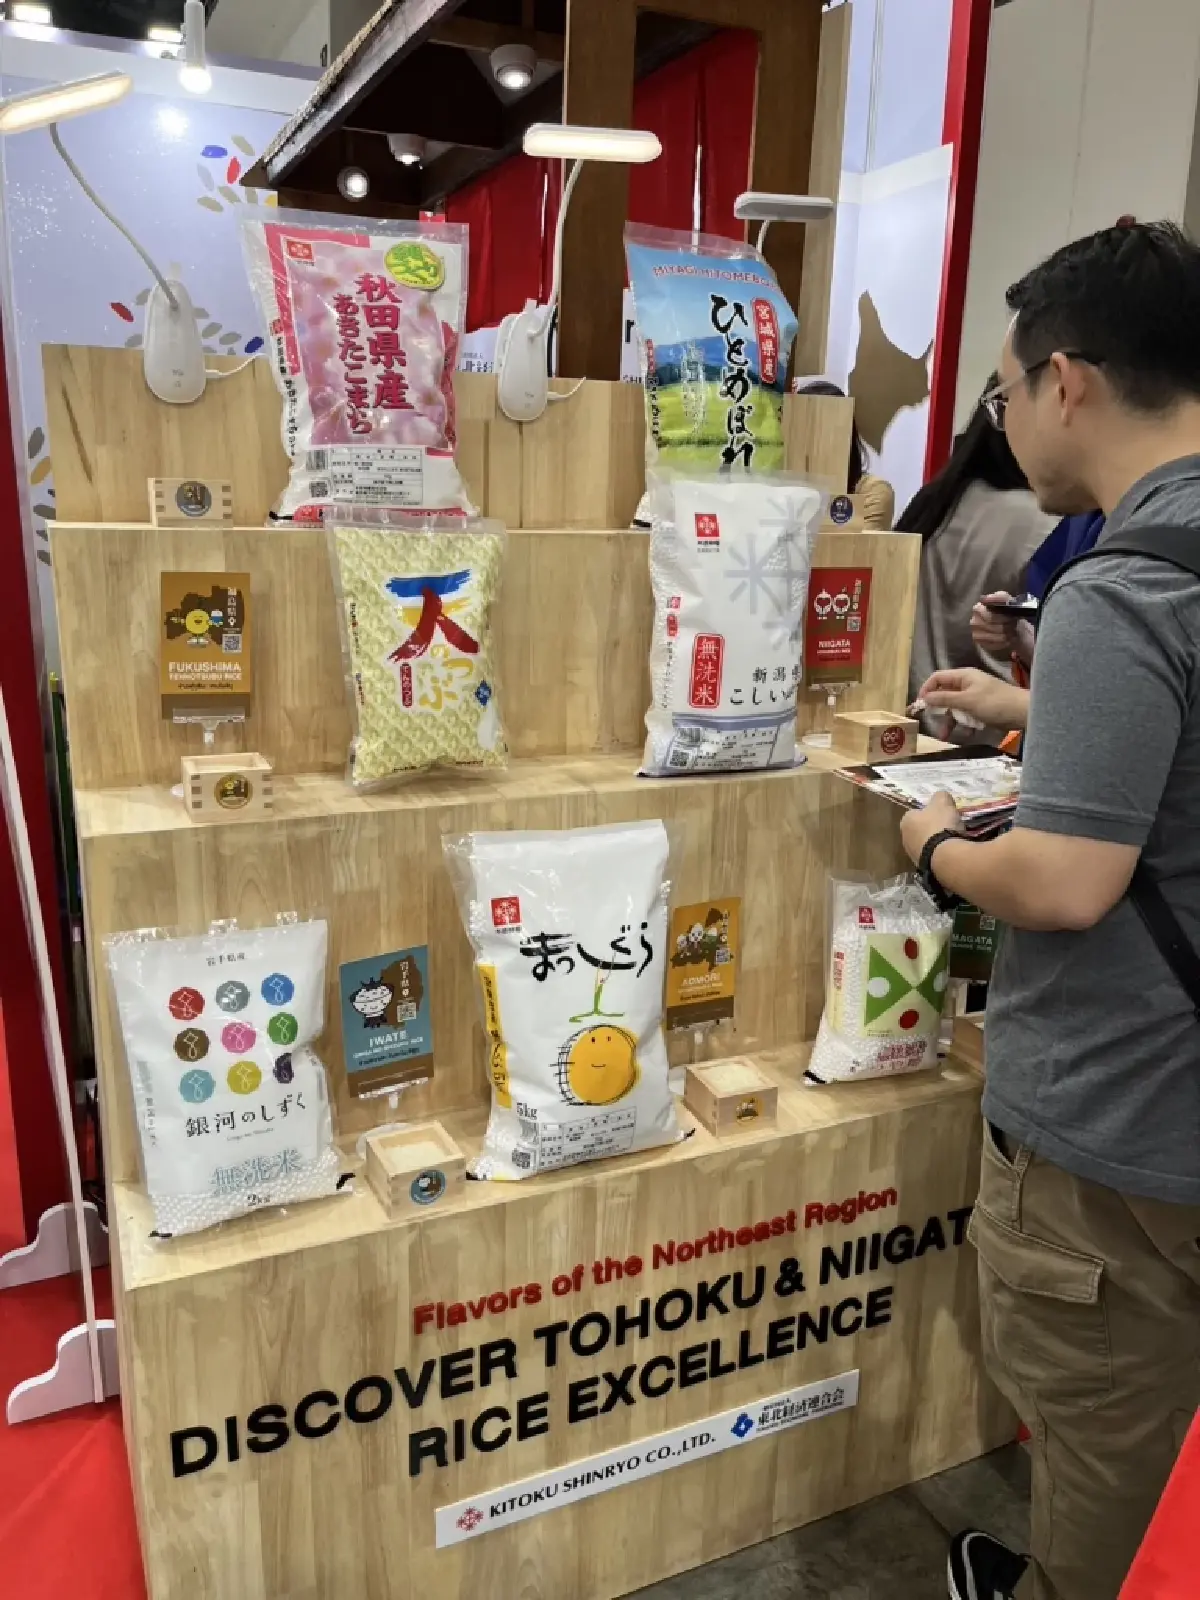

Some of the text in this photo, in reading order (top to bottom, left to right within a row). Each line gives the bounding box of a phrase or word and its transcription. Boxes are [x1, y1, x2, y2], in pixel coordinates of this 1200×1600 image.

[701, 268, 779, 290] HITOMEBO
[333, 291, 373, 435] あきたこまち
[355, 272, 414, 410] 秋田県産
[756, 304, 775, 378] 宮城県産
[710, 292, 755, 473] ひとめぼれ
[168, 661, 242, 673] FUKUSHIMA
[695, 638, 720, 705] 無洗米
[818, 638, 851, 648] NIIGATA
[519, 920, 654, 982] まっしぐら
[952, 933, 992, 946] MAGATA
[682, 971, 721, 987] AOMORI
[369, 1030, 407, 1048] IWATE
[185, 1091, 306, 1138] 銀河のしずく
[516, 1101, 538, 1120] 5kg
[413, 1186, 898, 1335] Flavors of the Northeast Region
[170, 1206, 972, 1478] DISCOVER TOHOKU & NIIGAT
[408, 1285, 895, 1478] RICE EXCELLENCE
[489, 1431, 717, 1518] KITOKU SHINRYO CO.,LTD.
